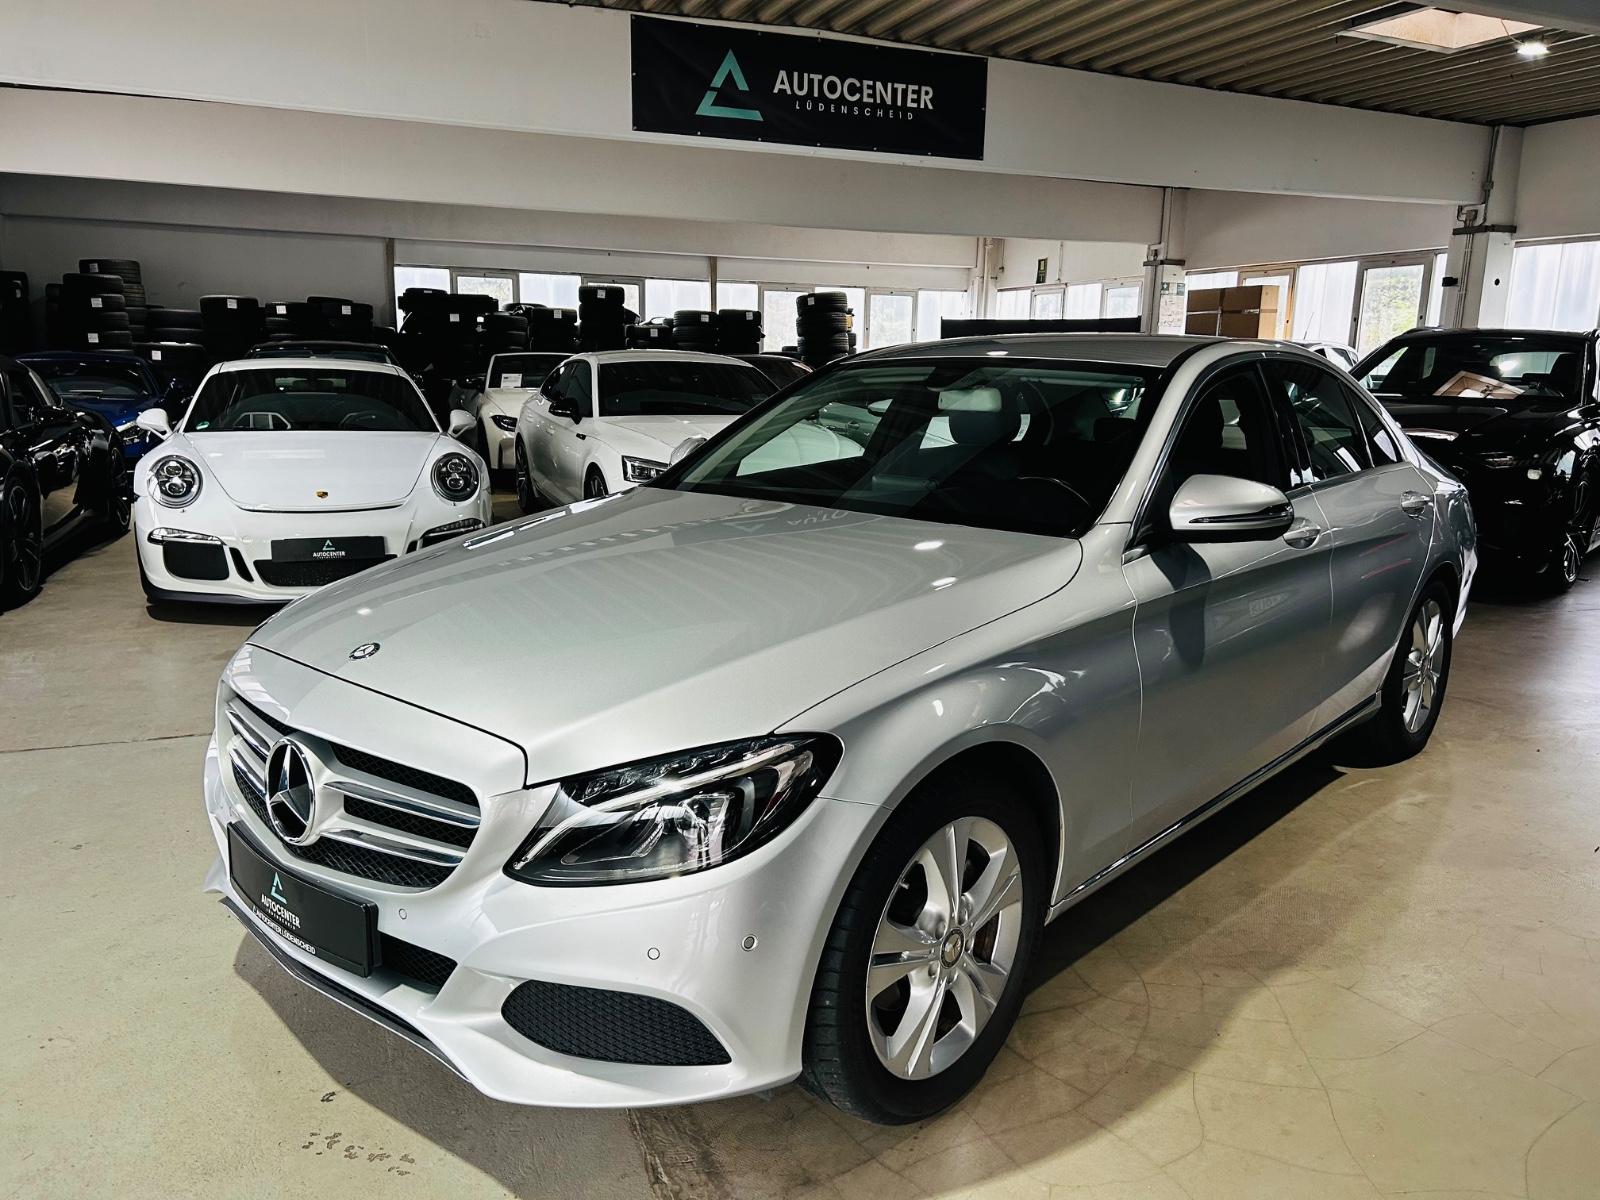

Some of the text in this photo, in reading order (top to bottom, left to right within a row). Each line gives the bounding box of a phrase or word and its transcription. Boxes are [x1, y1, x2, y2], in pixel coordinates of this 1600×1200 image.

[773, 70, 934, 109] AUTOCENTER
[796, 100, 913, 120] LÜDENSCHEID
[261, 893, 301, 929] AUTOCENTER
